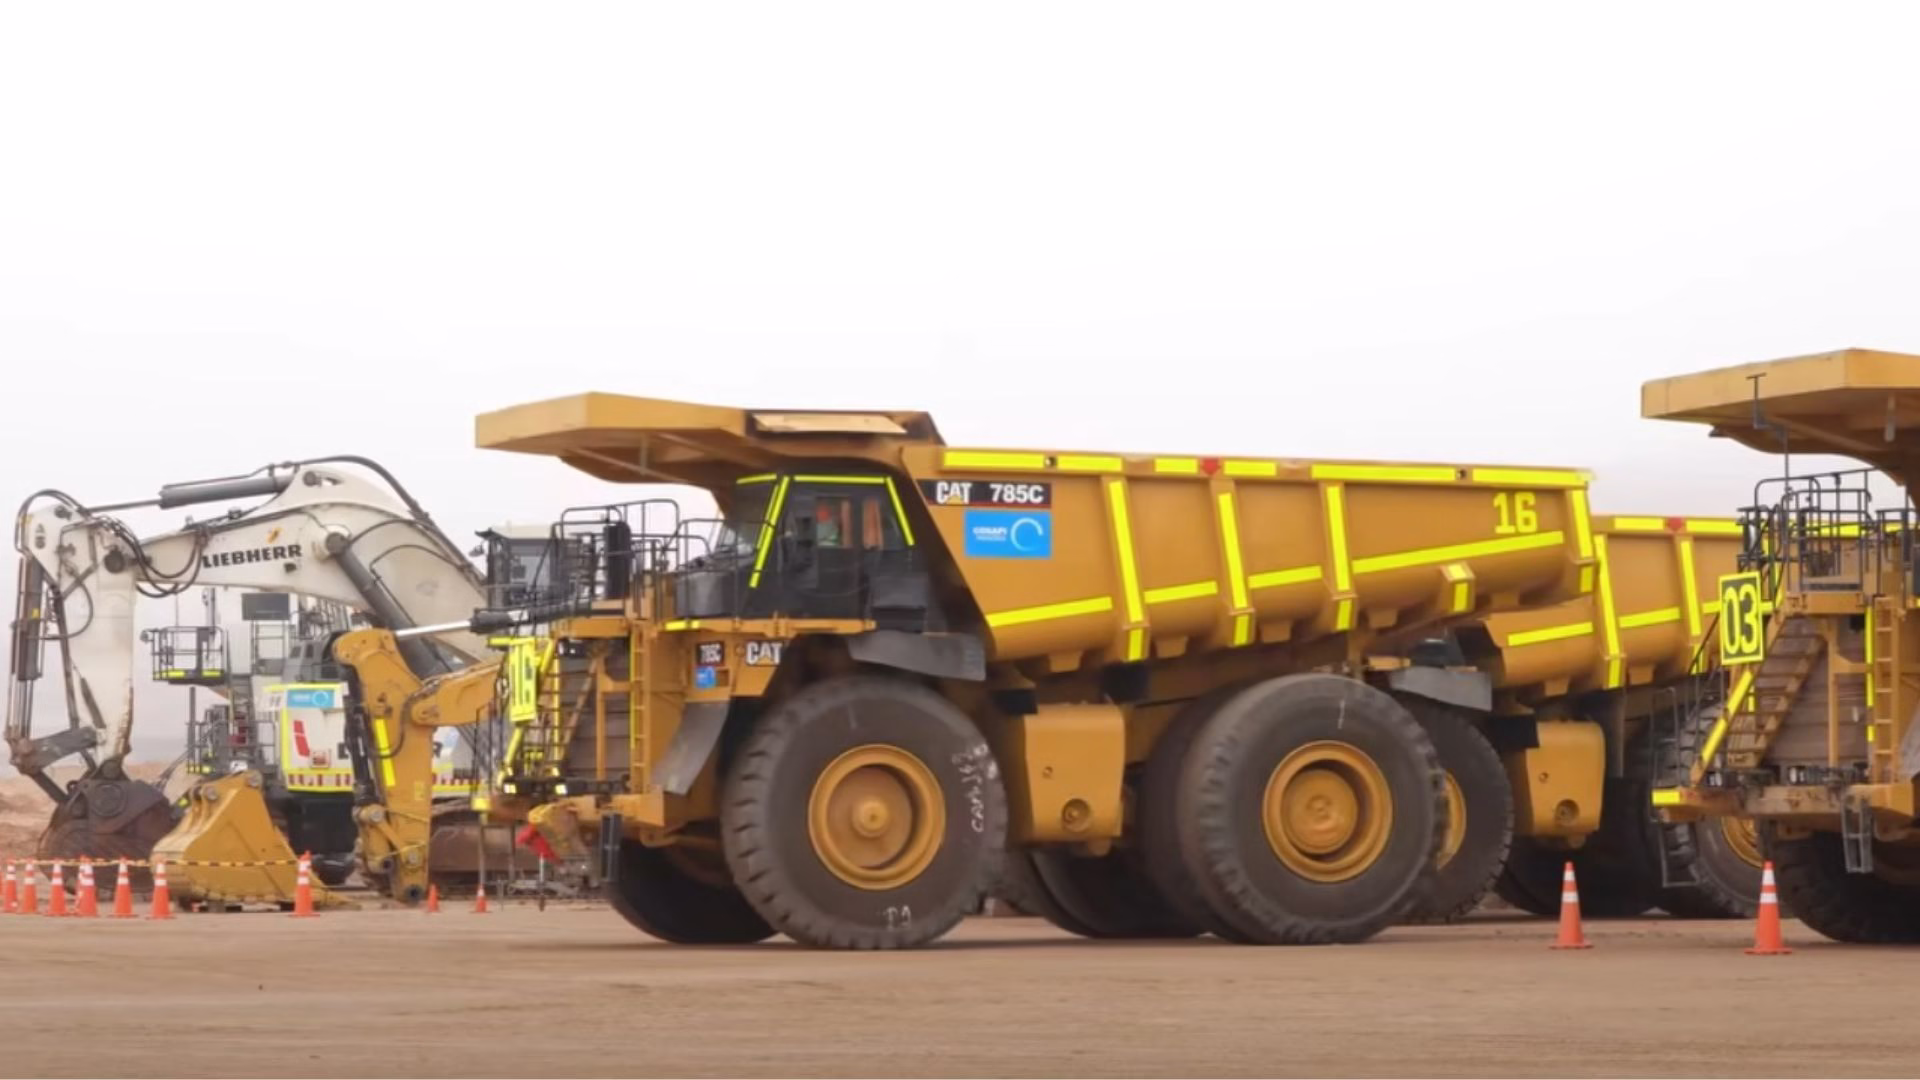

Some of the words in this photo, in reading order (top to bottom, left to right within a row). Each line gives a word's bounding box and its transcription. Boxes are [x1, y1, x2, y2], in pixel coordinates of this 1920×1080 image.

[936, 481, 972, 504] CAT
[989, 484, 1044, 504] 785C
[1493, 492, 1538, 534] 16
[202, 544, 303, 568] LIEBHERR
[1724, 584, 1758, 655] 03
[746, 642, 782, 665] CAT
